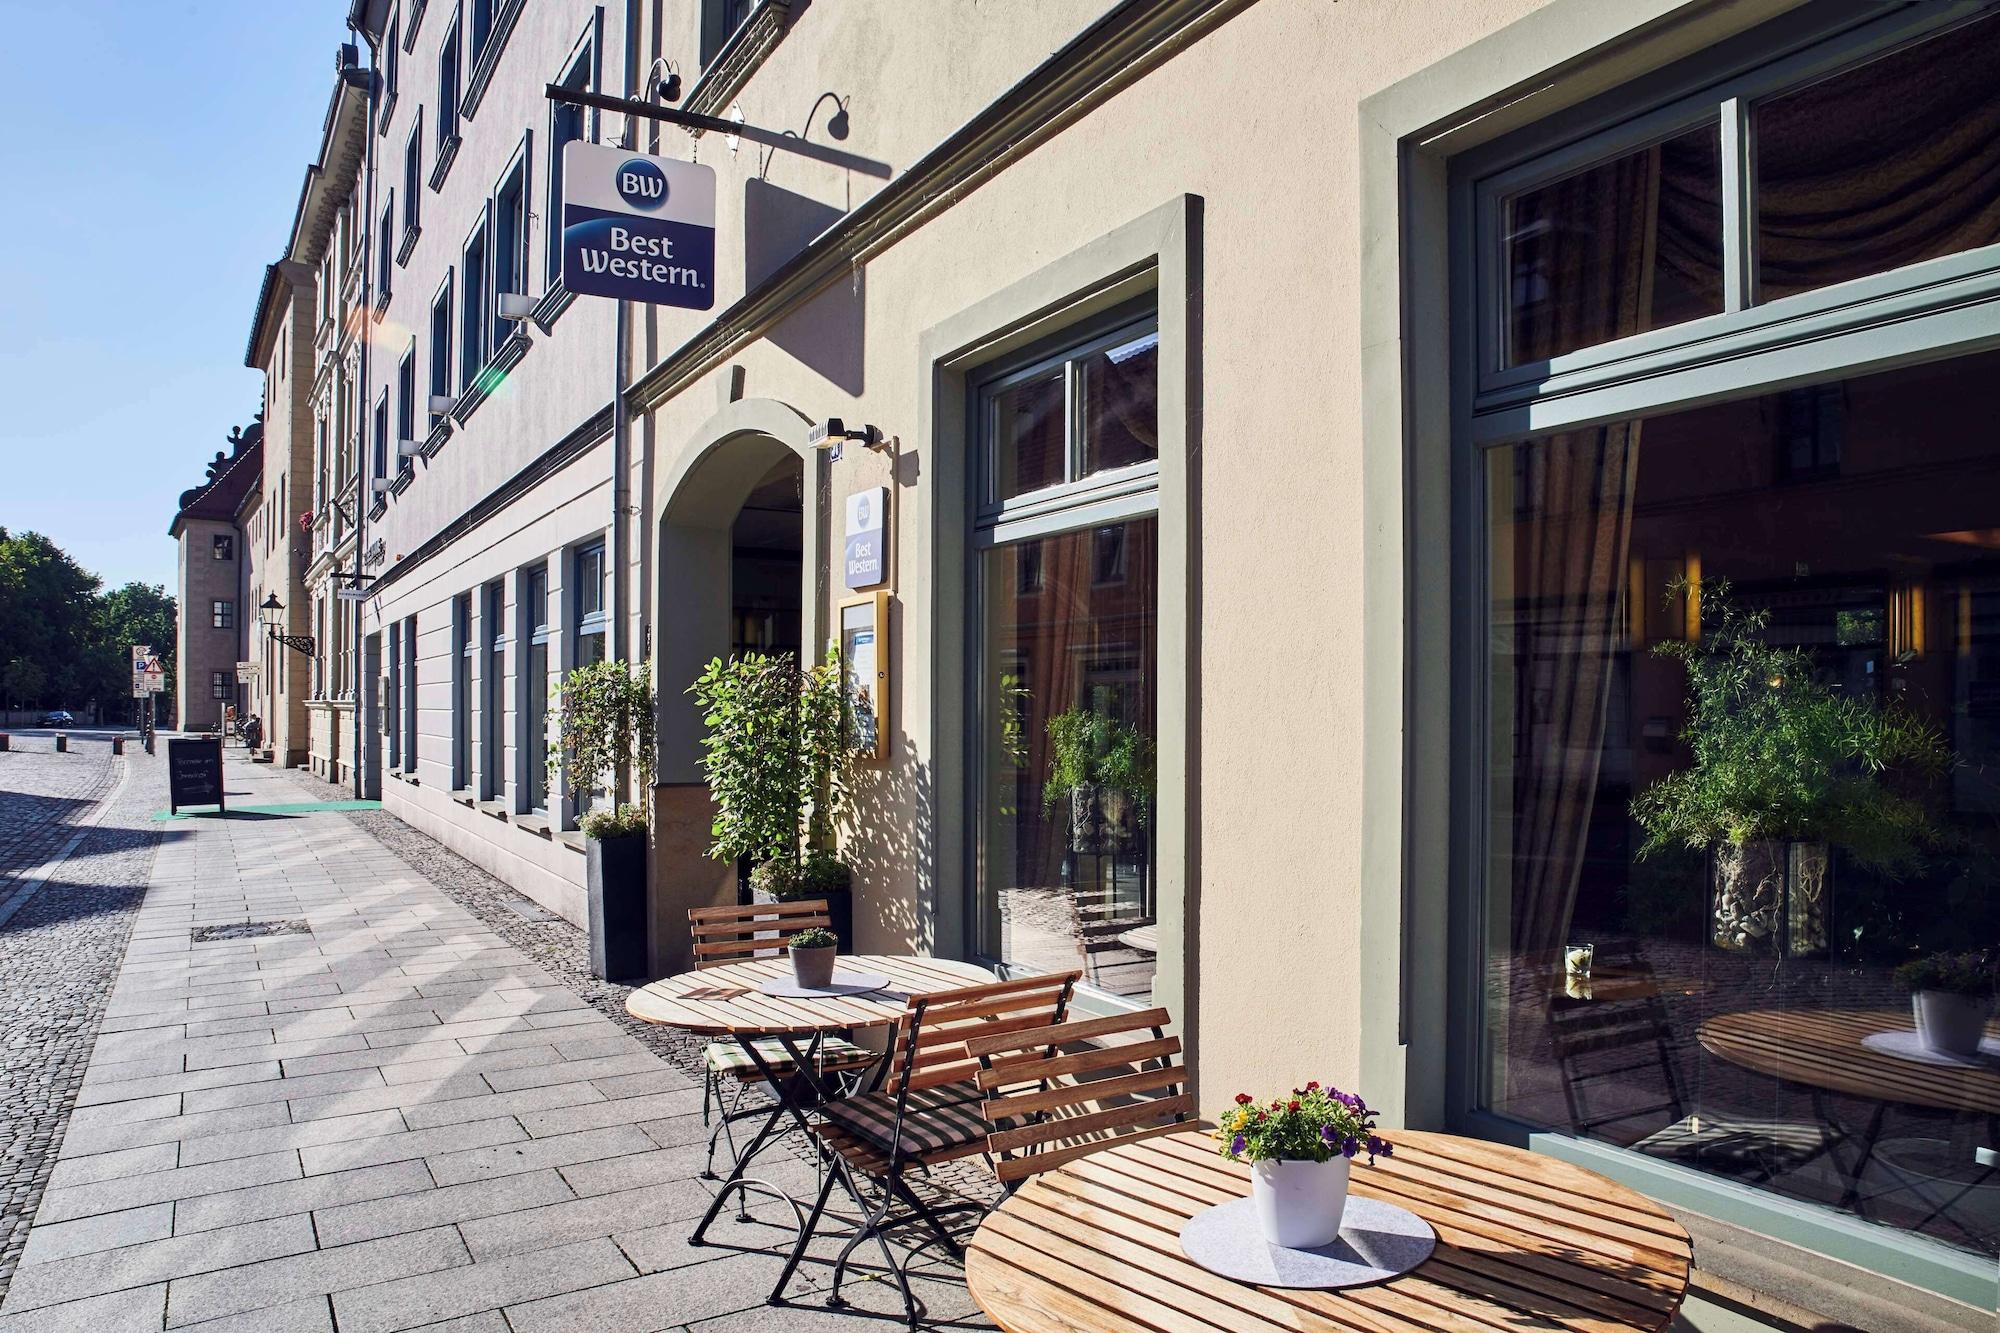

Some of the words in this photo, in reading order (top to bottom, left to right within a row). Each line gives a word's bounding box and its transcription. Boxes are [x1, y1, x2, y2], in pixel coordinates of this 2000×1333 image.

[622, 172, 664, 198] BW
[610, 227, 674, 259] Best
[581, 247, 699, 288] Western
[855, 542, 871, 559] Best
[848, 557, 878, 575] Western
